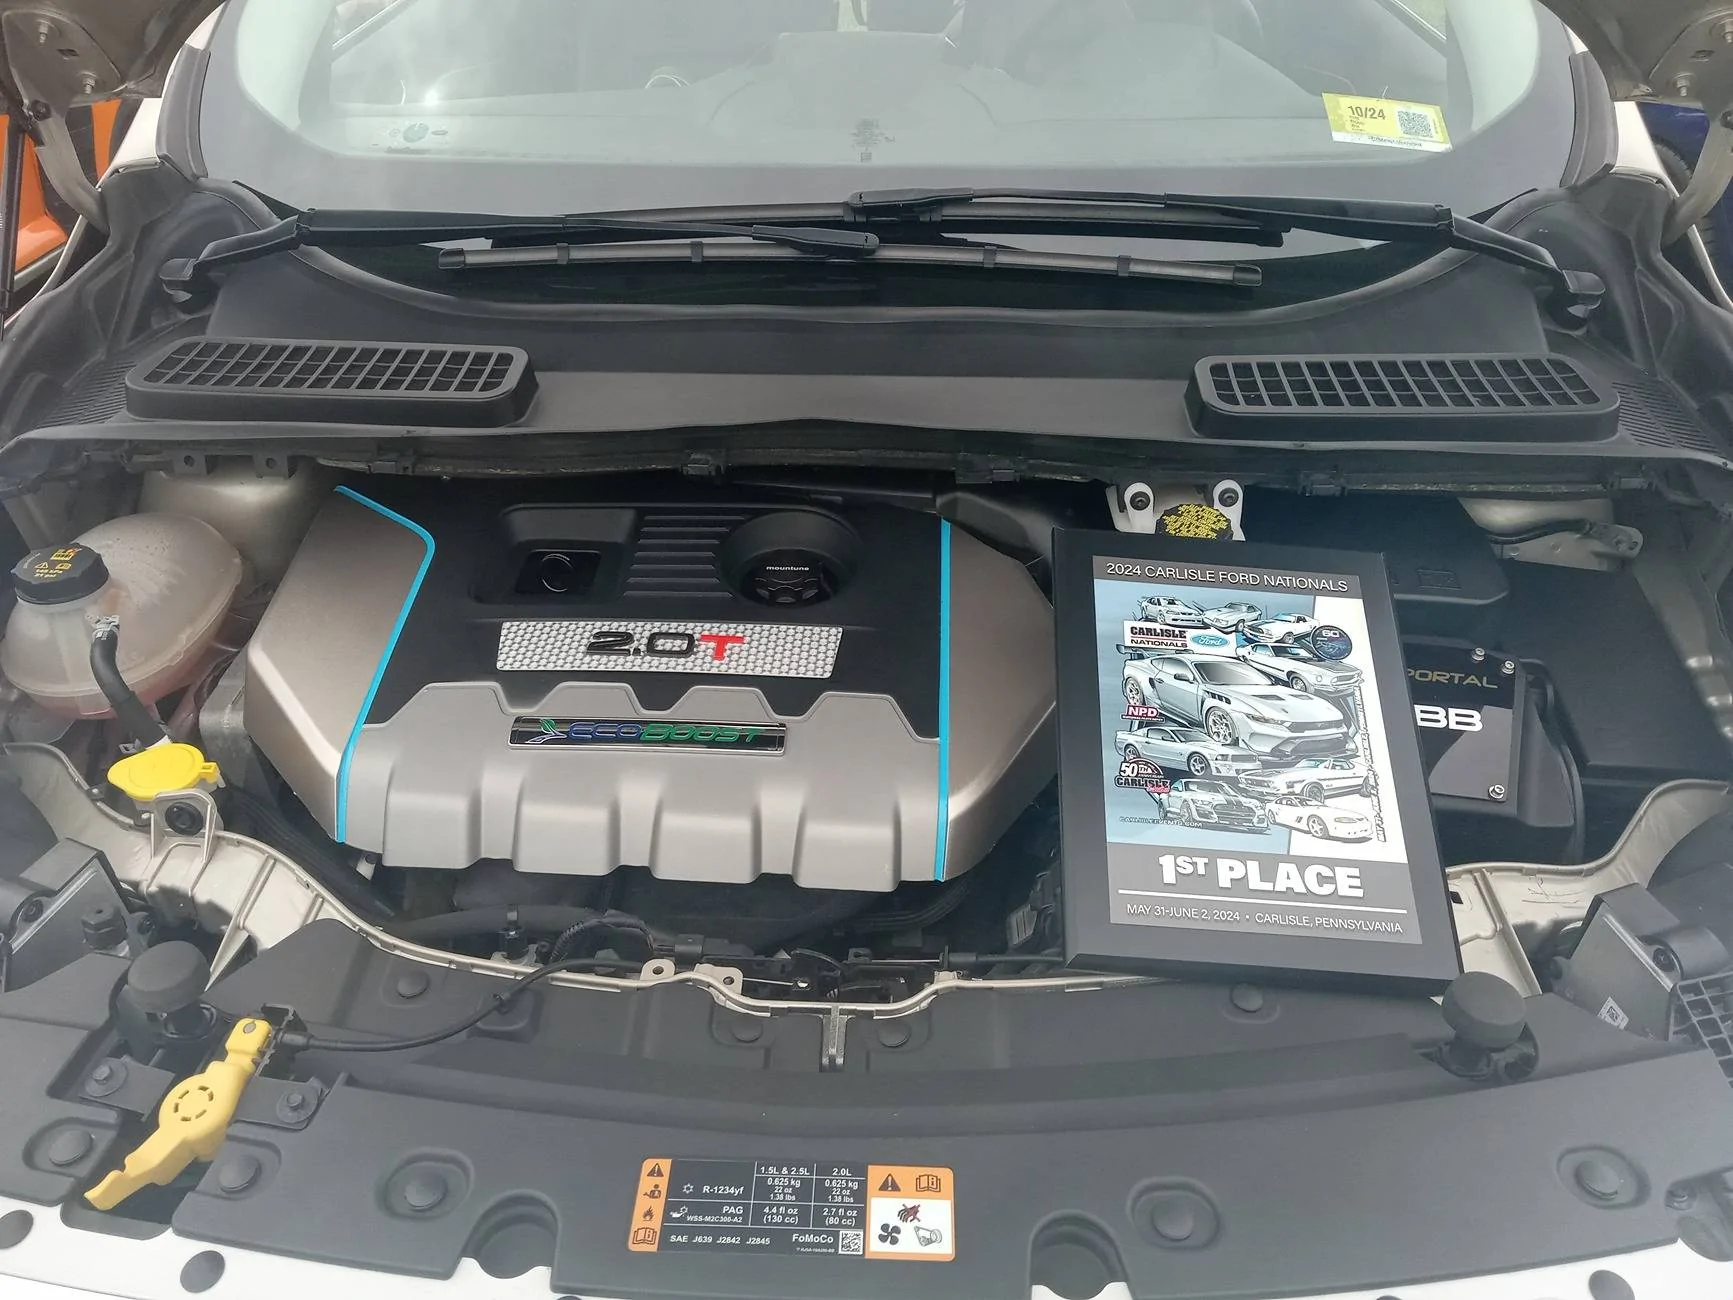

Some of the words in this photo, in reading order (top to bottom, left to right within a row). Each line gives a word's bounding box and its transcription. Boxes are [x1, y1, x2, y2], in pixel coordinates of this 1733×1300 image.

[1348, 105, 1386, 120] 10/24
[1106, 563, 1142, 576] 2024
[1145, 566, 1216, 582] CARLISLE
[1219, 571, 1260, 586] FORD
[1263, 575, 1348, 592] NATIONALS
[1130, 626, 1187, 639] CARLISLE
[1130, 639, 1188, 648] NATIONALS
[1199, 635, 1222, 645] Ford
[586, 631, 745, 662] 2.0T
[566, 721, 763, 744] ECOBOOST
[1116, 777, 1169, 789] CARLISLE
[1158, 854, 1209, 885] 1ST
[1216, 858, 1365, 898] PLACE
[1127, 904, 1152, 916] MAY
[1154, 905, 1199, 919] 31-JUNE
[1201, 909, 1212, 921] 2,
[1213, 910, 1241, 922] 2024
[1255, 912, 1313, 928] CARLISLE,
[1315, 917, 1404, 934] PENNSYLVANIA
[760, 1166, 779, 1175] 1.5L
[781, 1167, 789, 1175] &
[791, 1167, 810, 1176] 2.5L
[832, 1168, 852, 1176] 2.0L
[767, 1177, 789, 1186] 0.625
[790, 1178, 801, 1188] kg
[825, 1179, 847, 1187] 0.625
[848, 1180, 859, 1190] kg
[702, 1185, 745, 1197] R-1234yf
[722, 1205, 744, 1215] PAG
[763, 1206, 778, 1215] 4.4
[779, 1206, 786, 1215] fl
[823, 1208, 837, 1216] 2.7
[838, 1208, 845, 1216] fl
[763, 1215, 783, 1224] (130
[784, 1216, 799, 1224] cc)
[825, 1217, 840, 1226] (80
[841, 1217, 856, 1227] cc)
[670, 1235, 689, 1243] SAE
[692, 1235, 713, 1243] J639
[716, 1236, 741, 1244] J2842
[746, 1237, 771, 1245] J2845
[792, 1233, 834, 1244] FoMoCo
